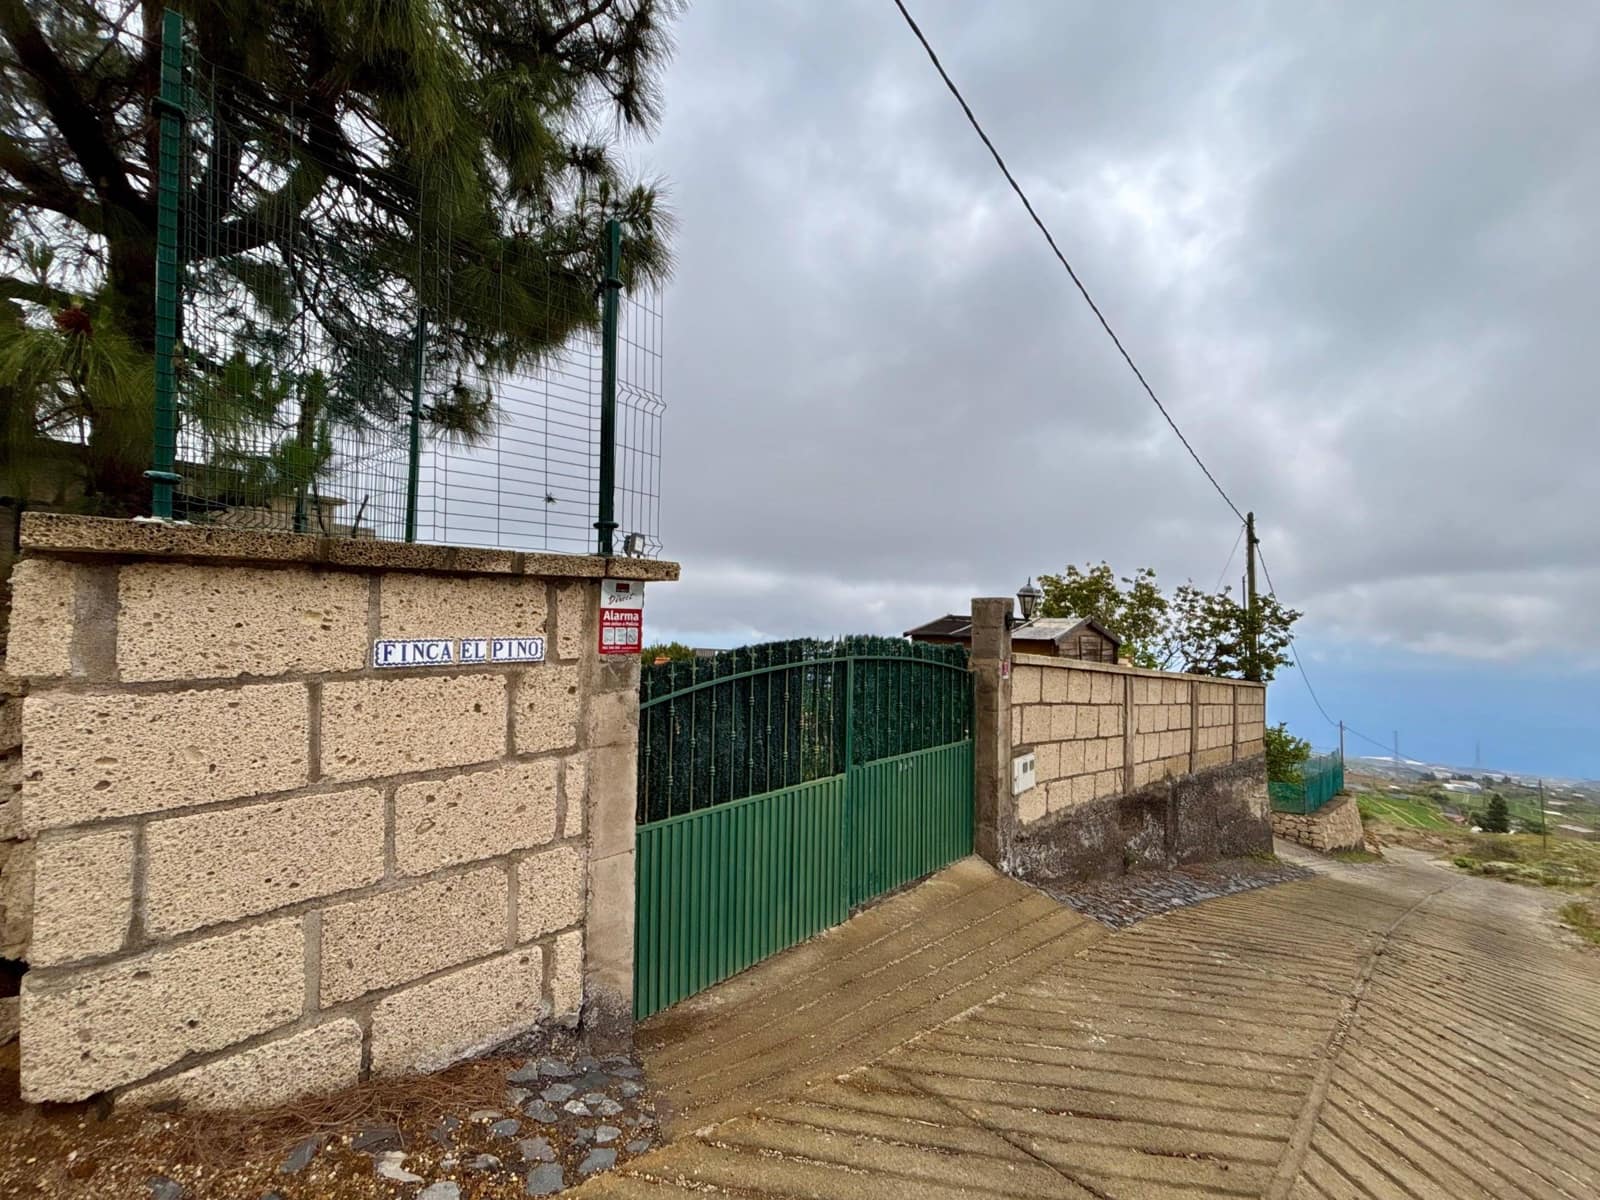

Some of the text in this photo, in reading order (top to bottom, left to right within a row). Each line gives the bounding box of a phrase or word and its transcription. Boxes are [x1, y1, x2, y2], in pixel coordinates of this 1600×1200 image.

[603, 610, 639, 621] Alarma
[383, 641, 539, 661] FINCA EL PINO
